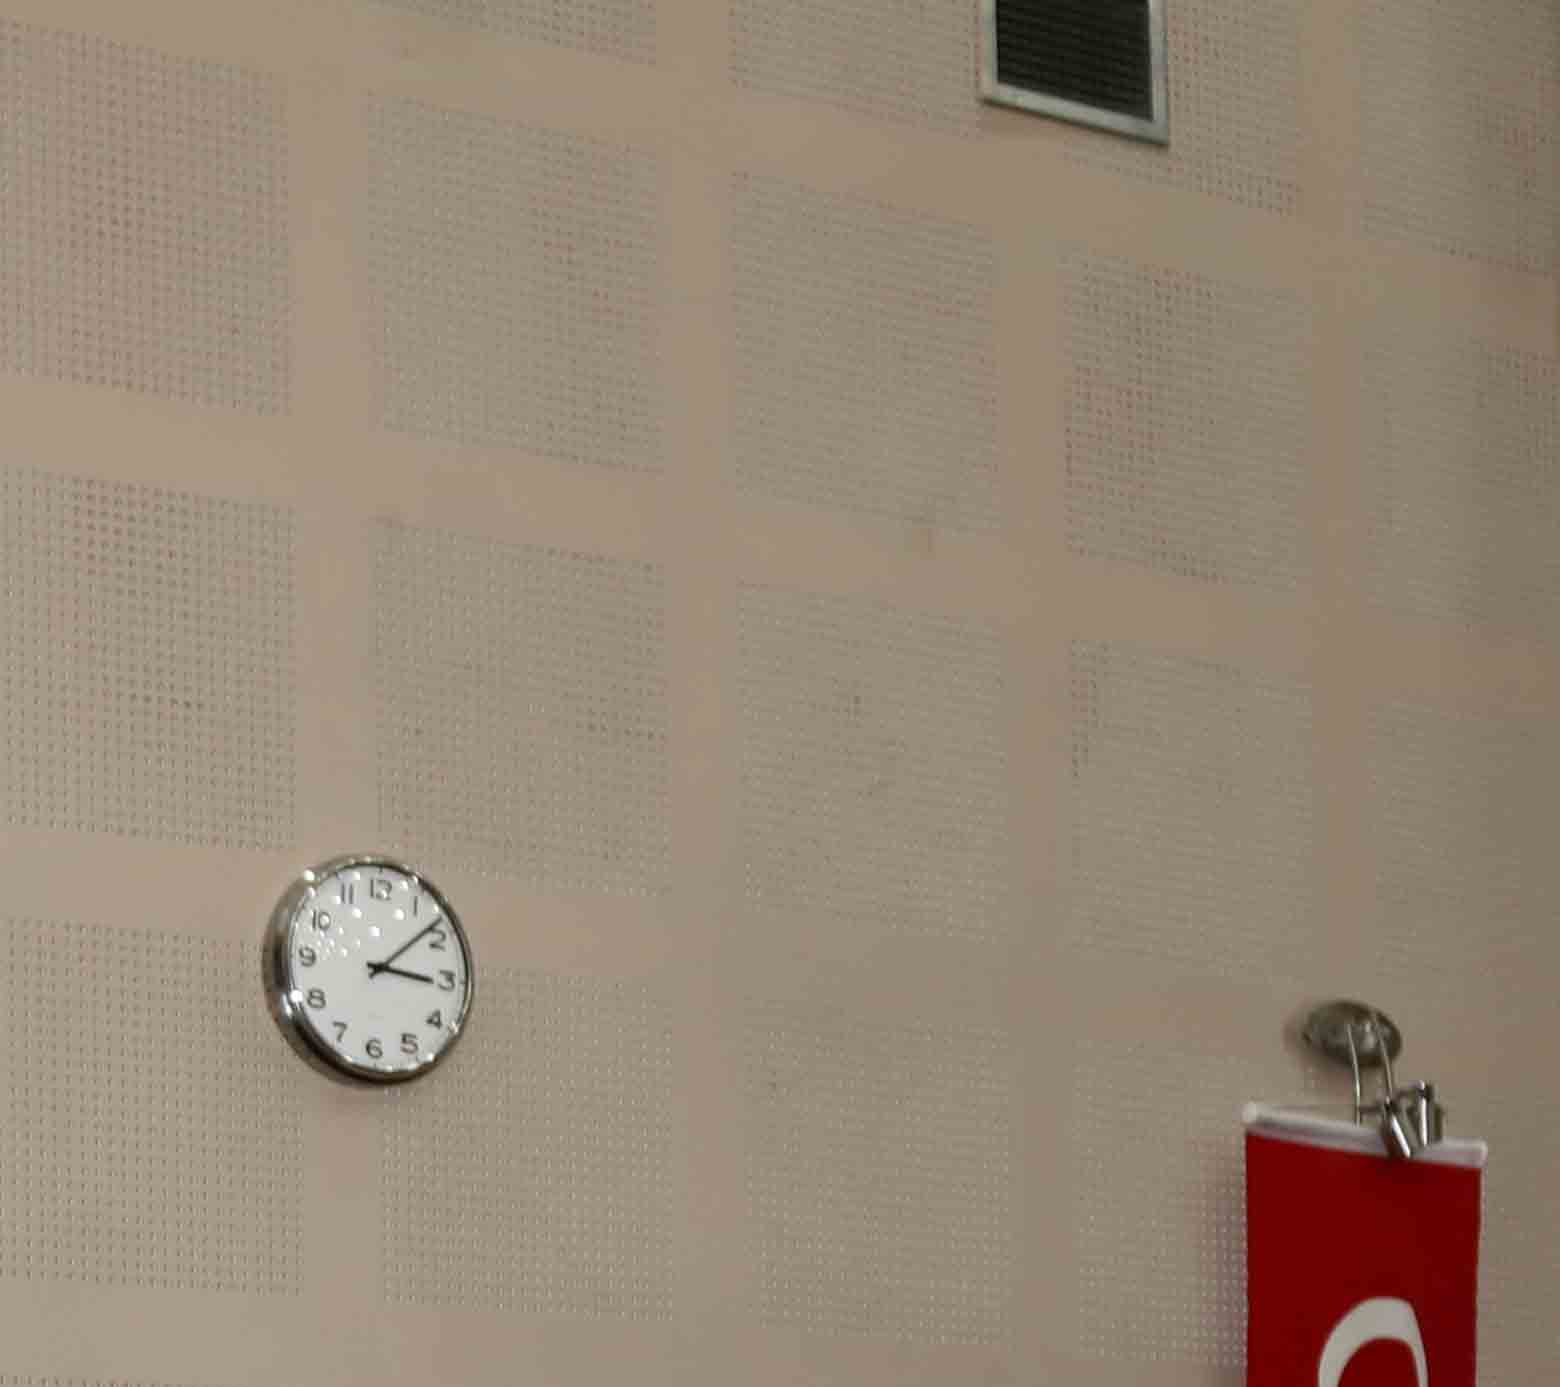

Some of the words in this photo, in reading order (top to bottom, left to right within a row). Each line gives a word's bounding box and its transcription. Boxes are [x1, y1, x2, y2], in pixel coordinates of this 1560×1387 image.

[340, 883, 355, 905] 11
[369, 878, 393, 900] 12
[311, 908, 331, 931] 10
[428, 928, 447, 951] 2
[298, 947, 317, 967] 9
[437, 969, 457, 992] 3
[306, 988, 326, 1009] 8
[426, 1010, 442, 1029] 4
[332, 1021, 348, 1043] 7
[365, 1037, 384, 1058] 6
[400, 1033, 420, 1054] 5
